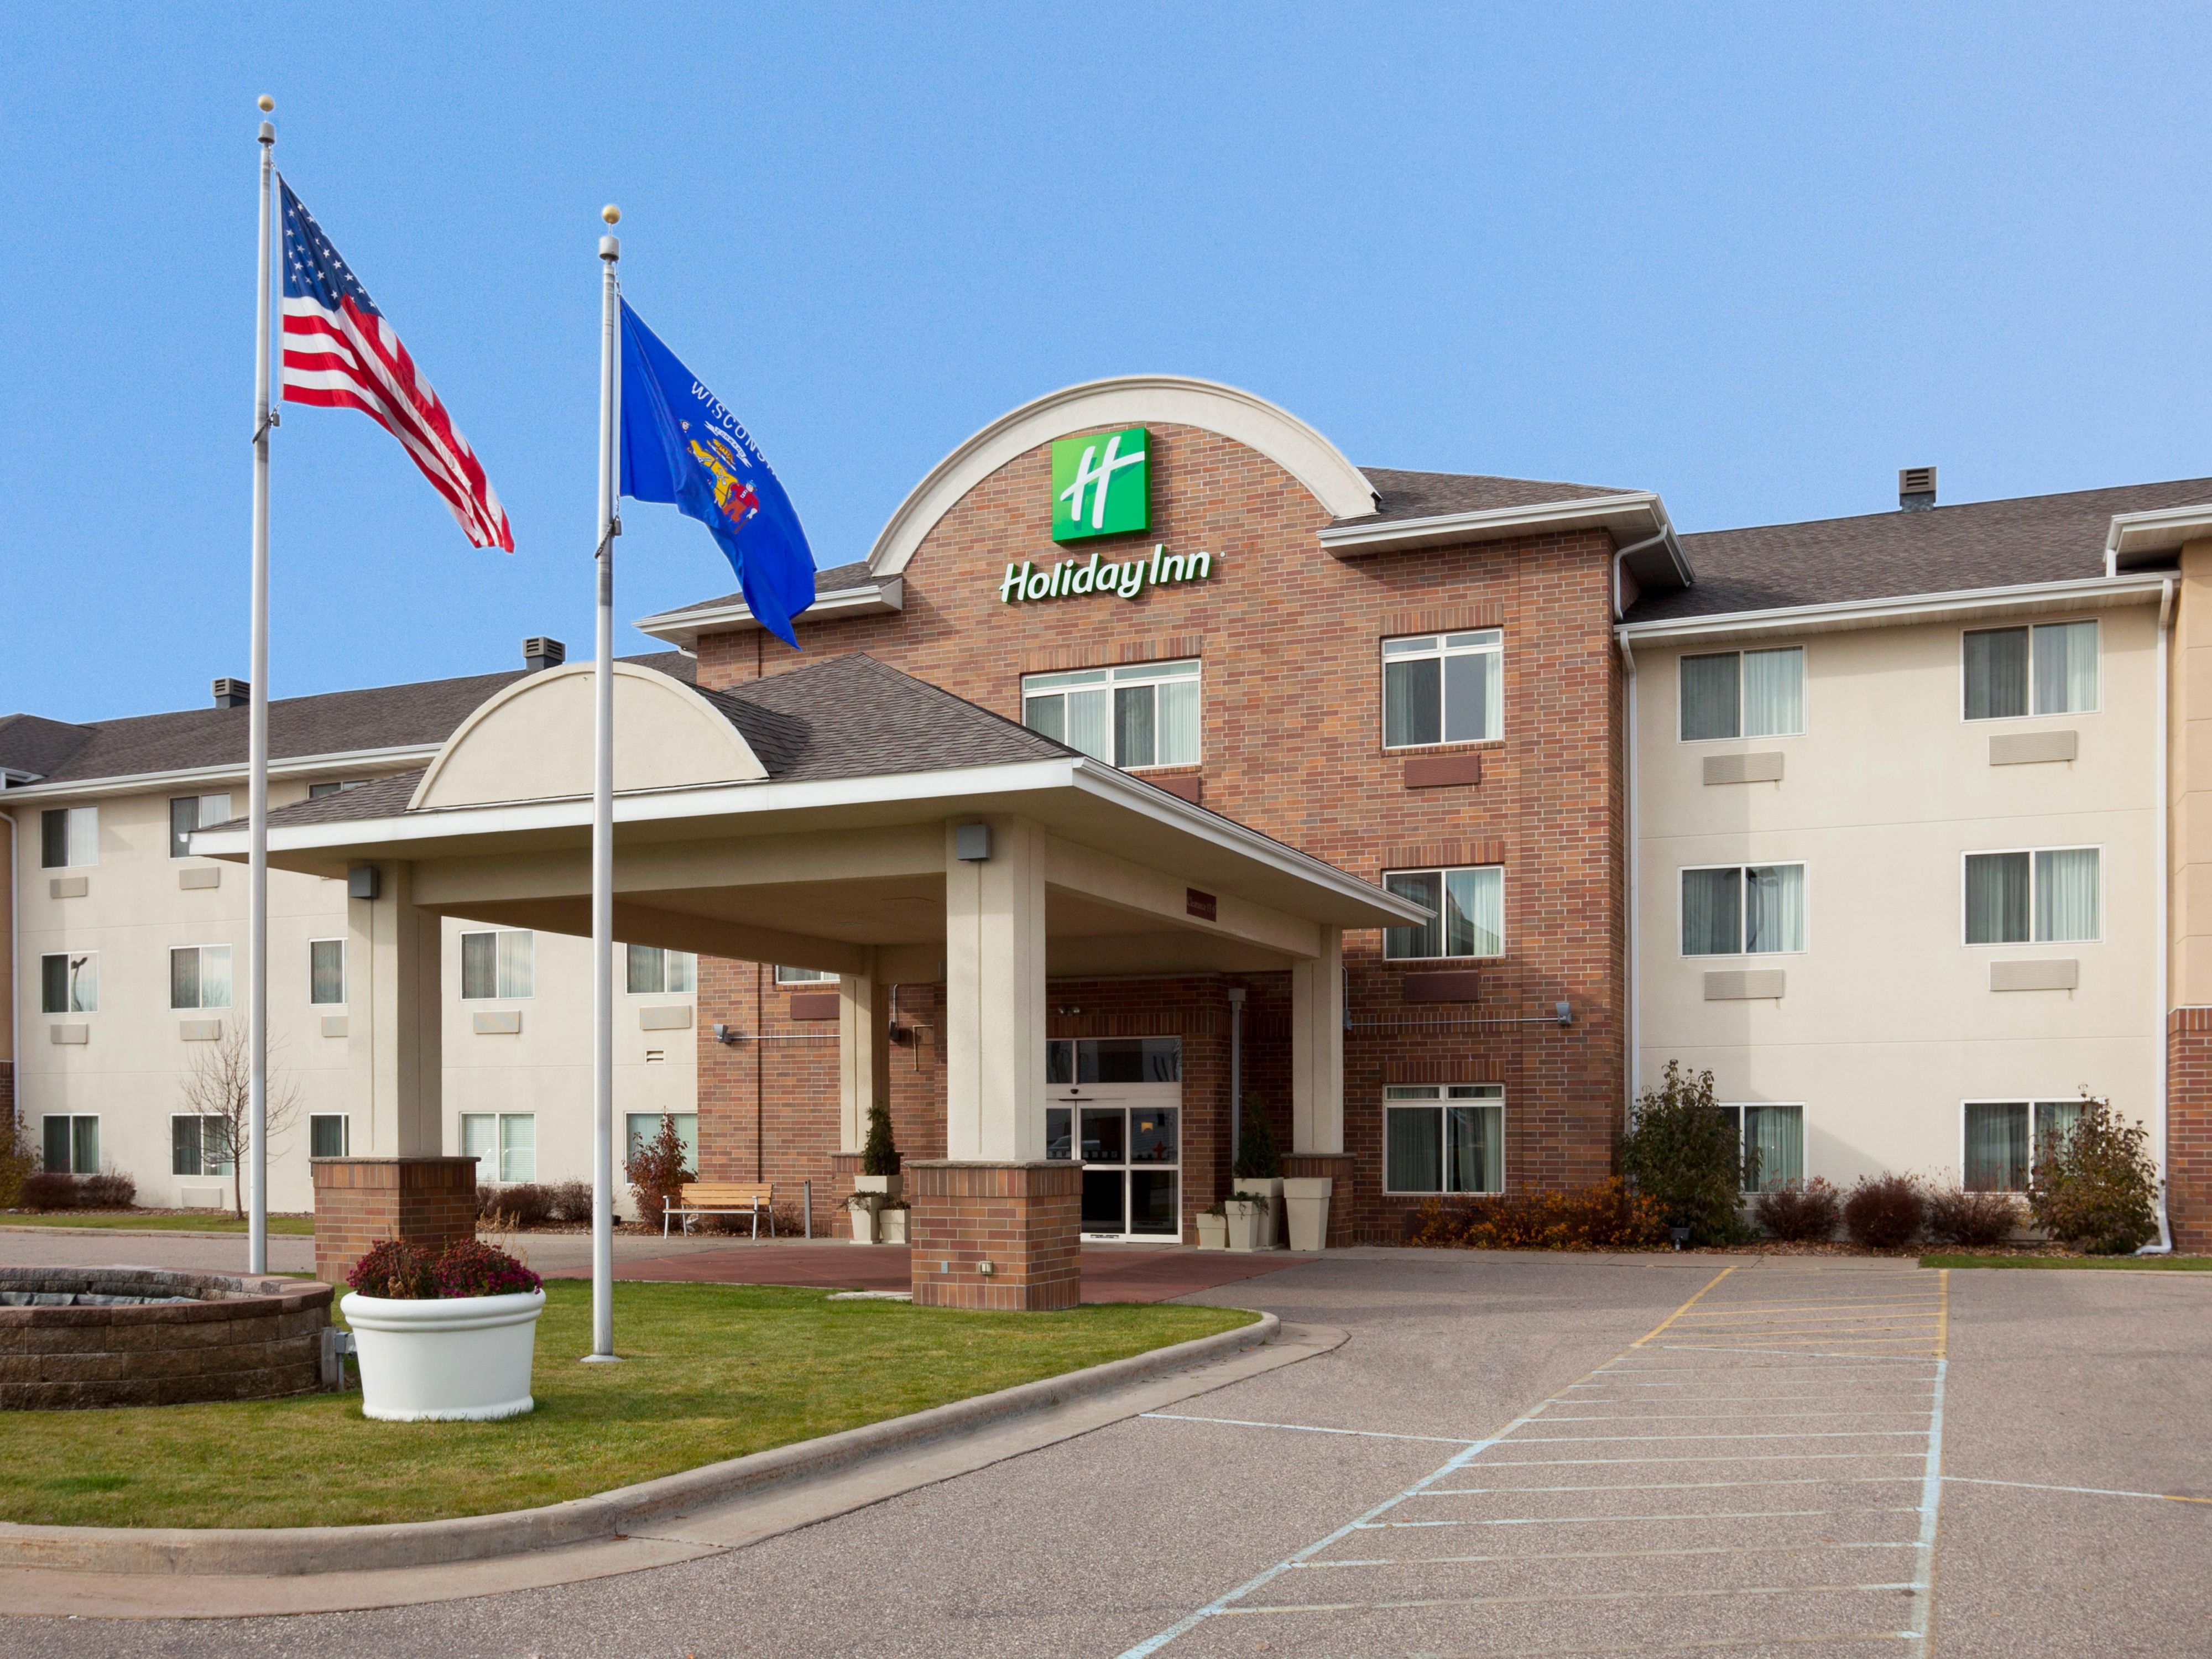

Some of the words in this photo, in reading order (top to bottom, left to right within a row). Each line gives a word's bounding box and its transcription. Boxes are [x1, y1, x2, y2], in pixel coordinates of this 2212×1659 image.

[691, 381, 775, 479] WISCON
[1060, 435, 1145, 529] H
[999, 553, 1147, 603] Holiday
[1150, 544, 1212, 585] Inn
